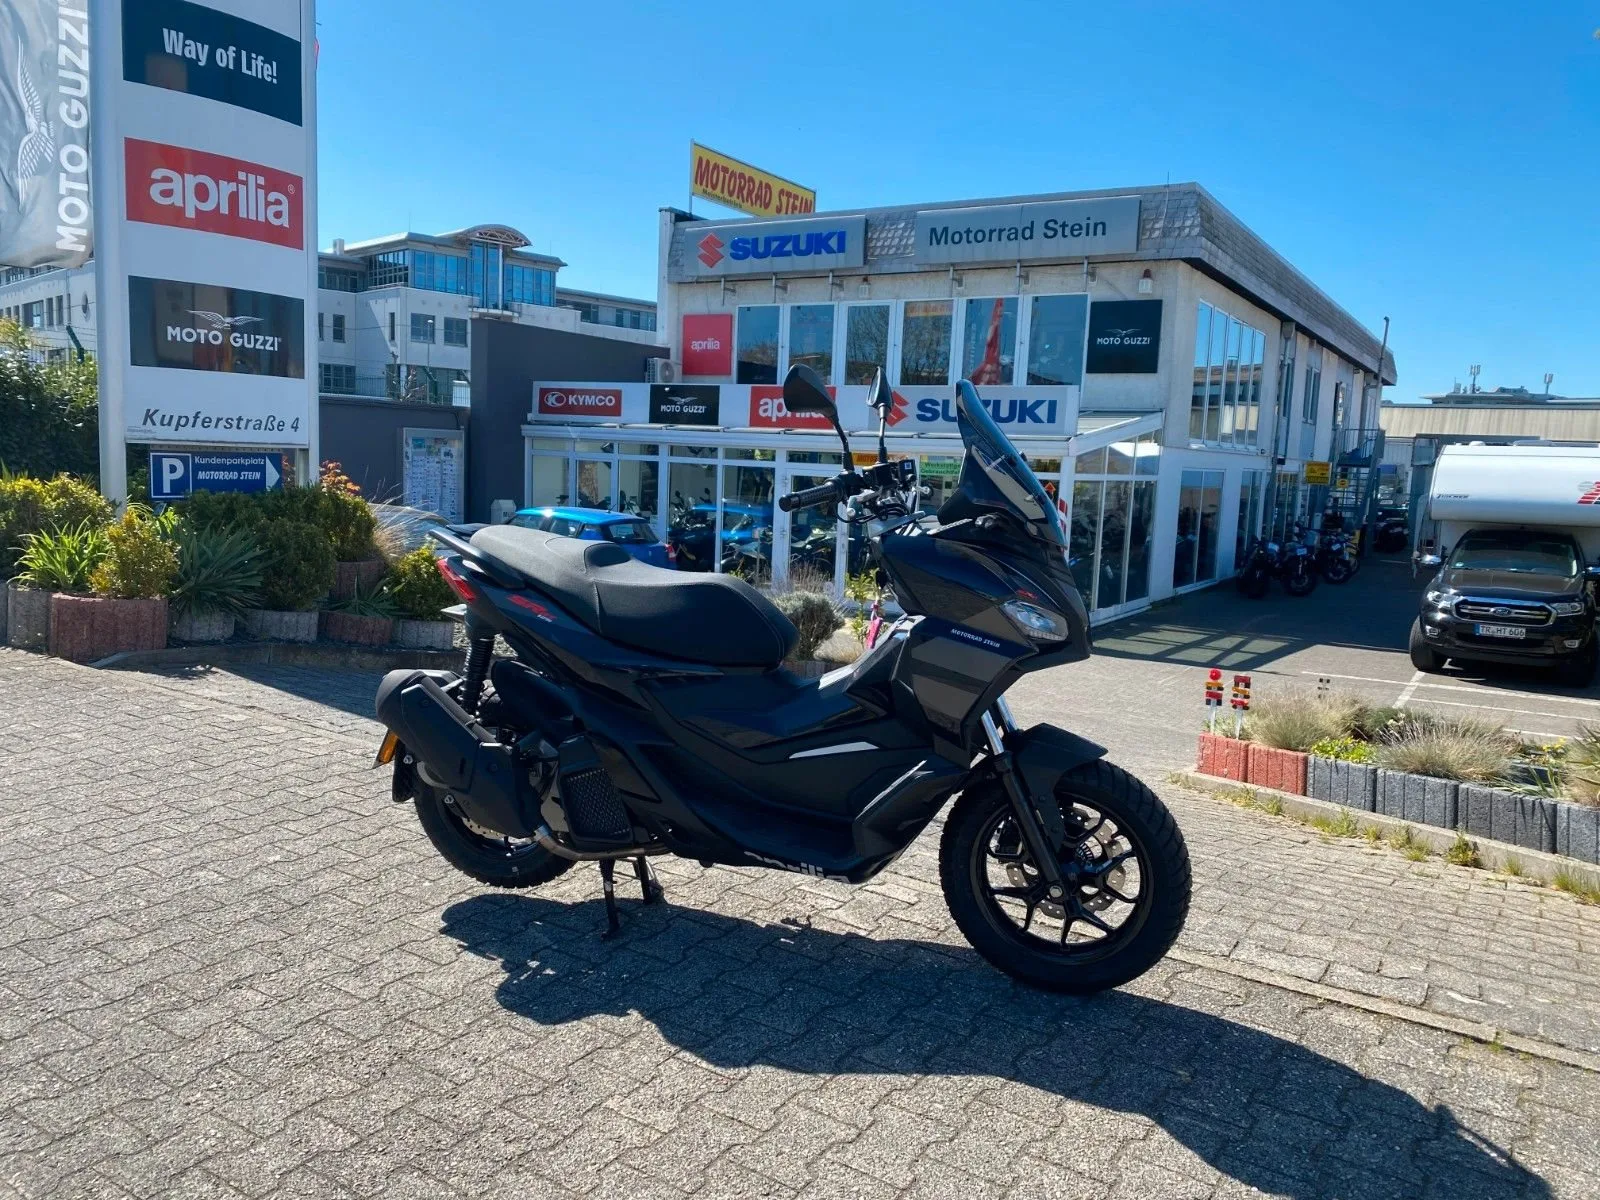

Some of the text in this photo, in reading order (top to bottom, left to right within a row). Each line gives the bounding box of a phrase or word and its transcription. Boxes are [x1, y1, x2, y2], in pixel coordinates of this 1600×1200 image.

[162, 27, 278, 84] Way of Life!
[56, 6, 88, 252] MOTO GUZZI
[694, 155, 813, 215] MOTORRAD STEIN
[929, 217, 1107, 247] Motorrad Stein
[730, 230, 847, 261] SUZUKI
[166, 325, 279, 351] MOTO GUZZI
[691, 337, 721, 352] aprilia
[1096, 336, 1151, 345] MOTO GUZZI
[568, 394, 616, 407] KYMCO
[660, 404, 706, 414] MOTO GUZZI
[915, 398, 1058, 424] SUUKI
[142, 408, 286, 432] Kupferstraße
[290, 416, 301, 433] 4
[194, 456, 265, 466] Kundenparkplatz
[161, 457, 185, 494] P
[197, 470, 261, 480] MOTORRAD STEIN
[950, 628, 1001, 649] MOTORRAD STEIN
